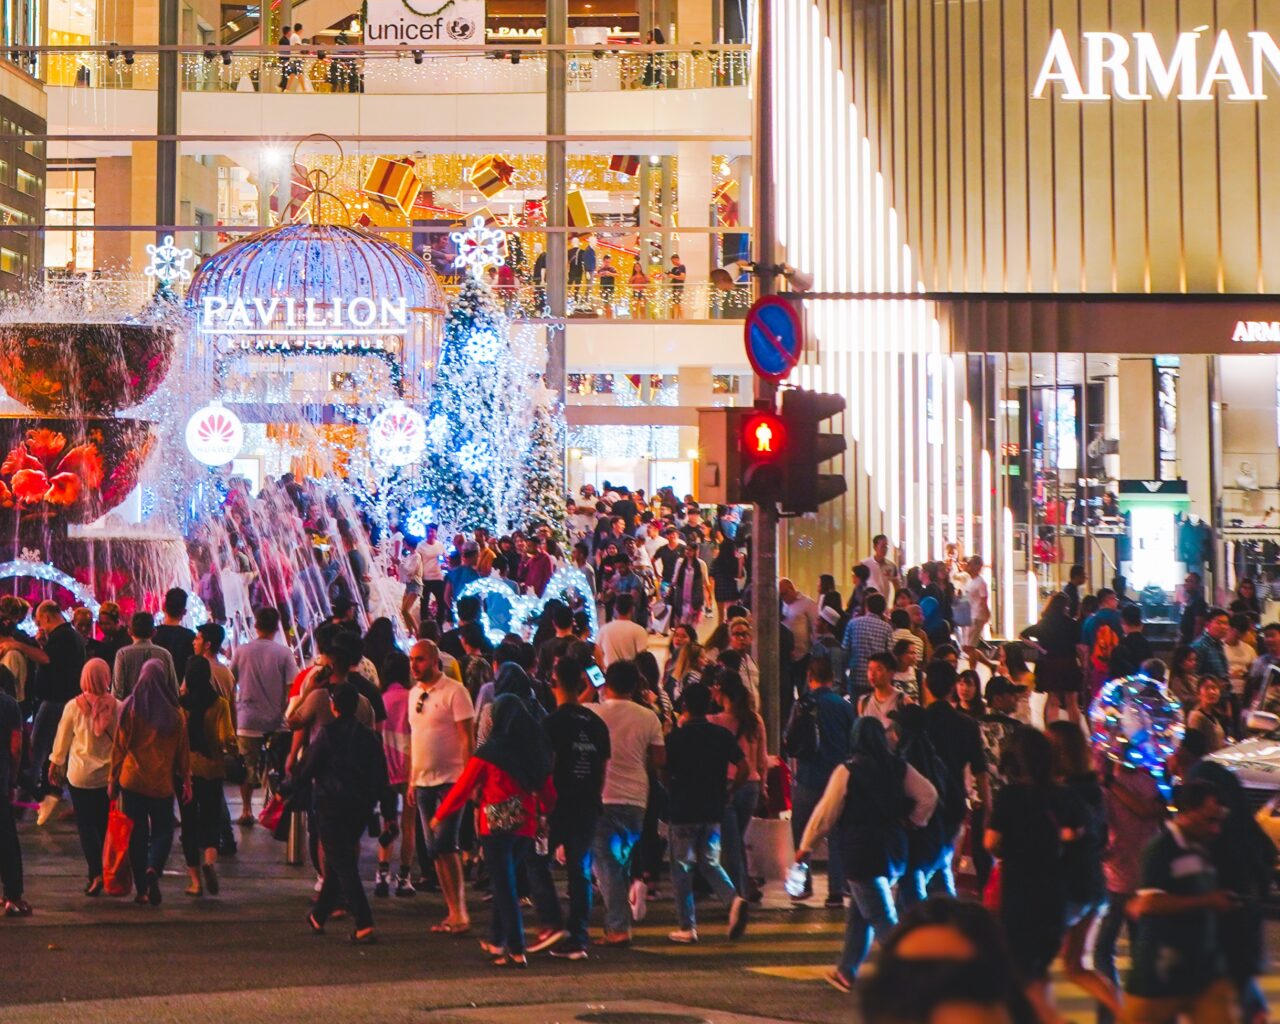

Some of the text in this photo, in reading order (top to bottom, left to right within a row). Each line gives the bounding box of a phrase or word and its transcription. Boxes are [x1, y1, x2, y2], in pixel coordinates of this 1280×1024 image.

[368, 17, 444, 40] unicef
[202, 296, 408, 327] PAVILION
[228, 338, 385, 350] KUALA LUMPUR
